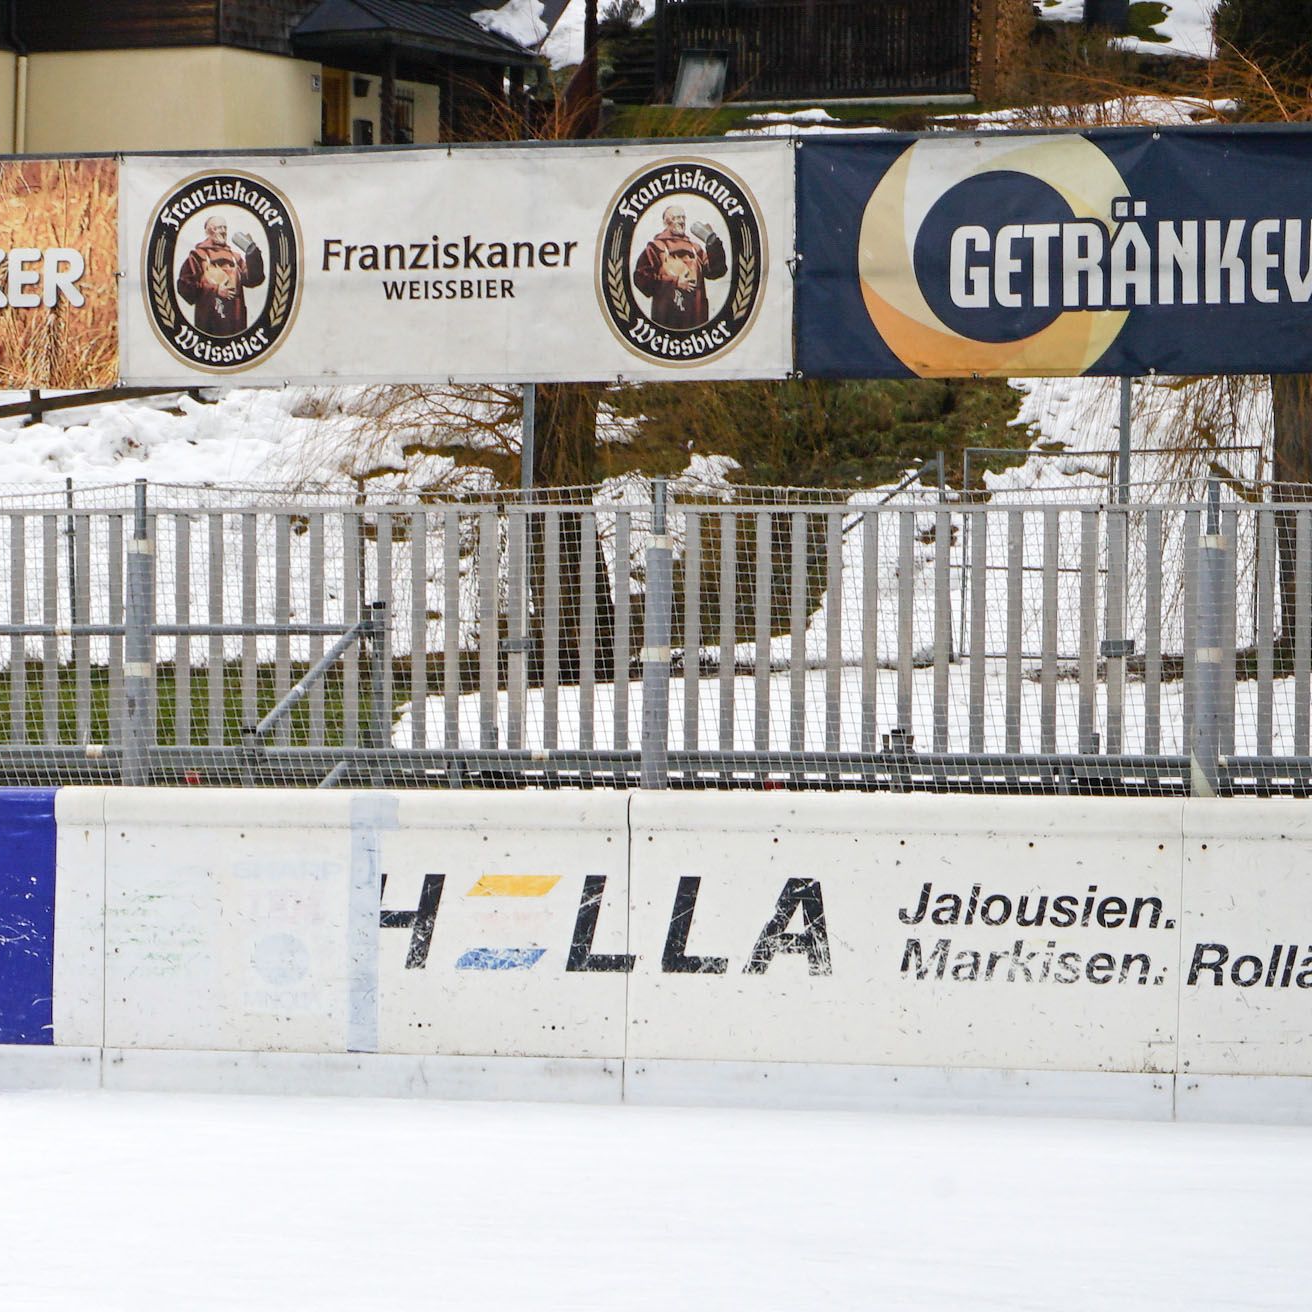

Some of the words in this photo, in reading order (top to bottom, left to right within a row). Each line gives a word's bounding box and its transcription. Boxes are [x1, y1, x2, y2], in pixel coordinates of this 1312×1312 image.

[160, 180, 284, 231] Franziskaner
[619, 168, 745, 223] Franziskaner
[322, 235, 579, 271] Franziskaner
[950, 201, 1312, 307] GETRÄNKEV
[382, 279, 516, 300] WEISSBIER
[175, 325, 270, 363] Weissbier
[629, 318, 732, 357] Weissbier
[898, 882, 1176, 929] Jalousien.
[900, 938, 1166, 986] Markisen.
